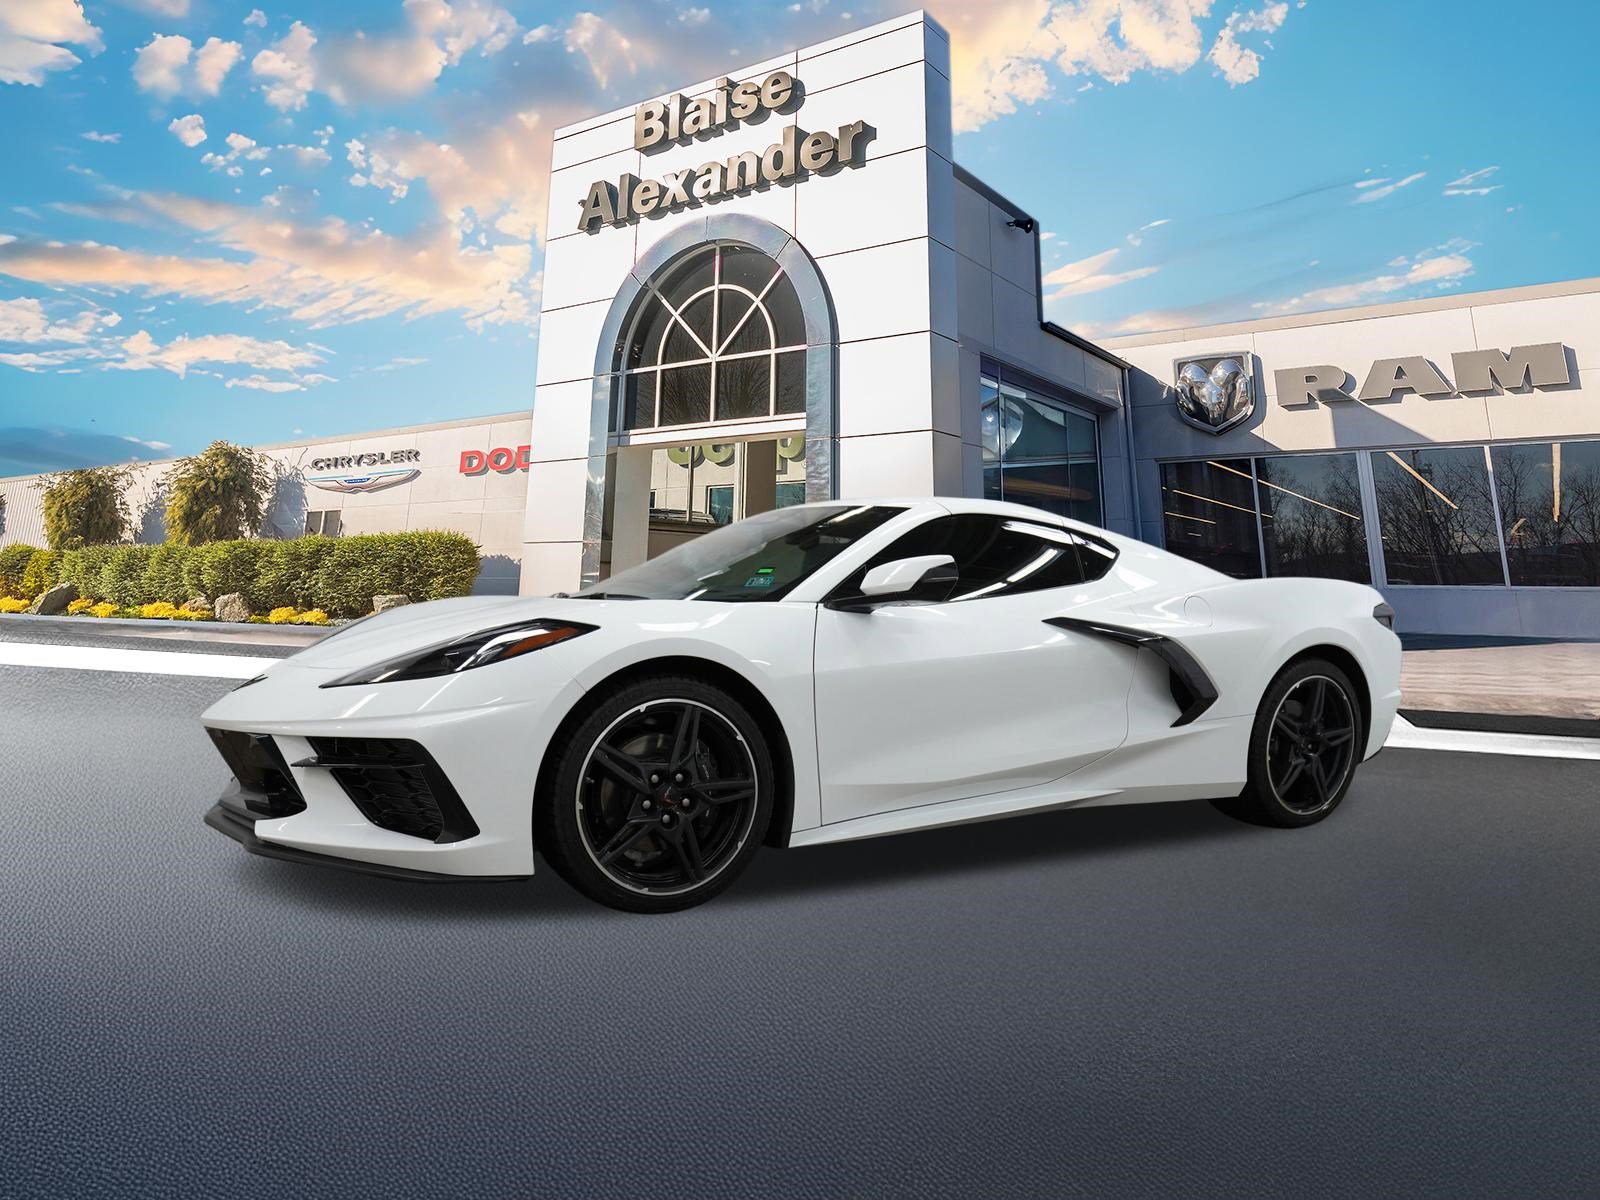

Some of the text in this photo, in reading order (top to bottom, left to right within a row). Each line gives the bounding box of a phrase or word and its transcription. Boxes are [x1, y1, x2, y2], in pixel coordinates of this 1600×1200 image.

[634, 70, 801, 154] Blaise
[577, 119, 873, 234] Alexander
[1274, 342, 1574, 409] RAM
[311, 448, 420, 471] CHRYSLER
